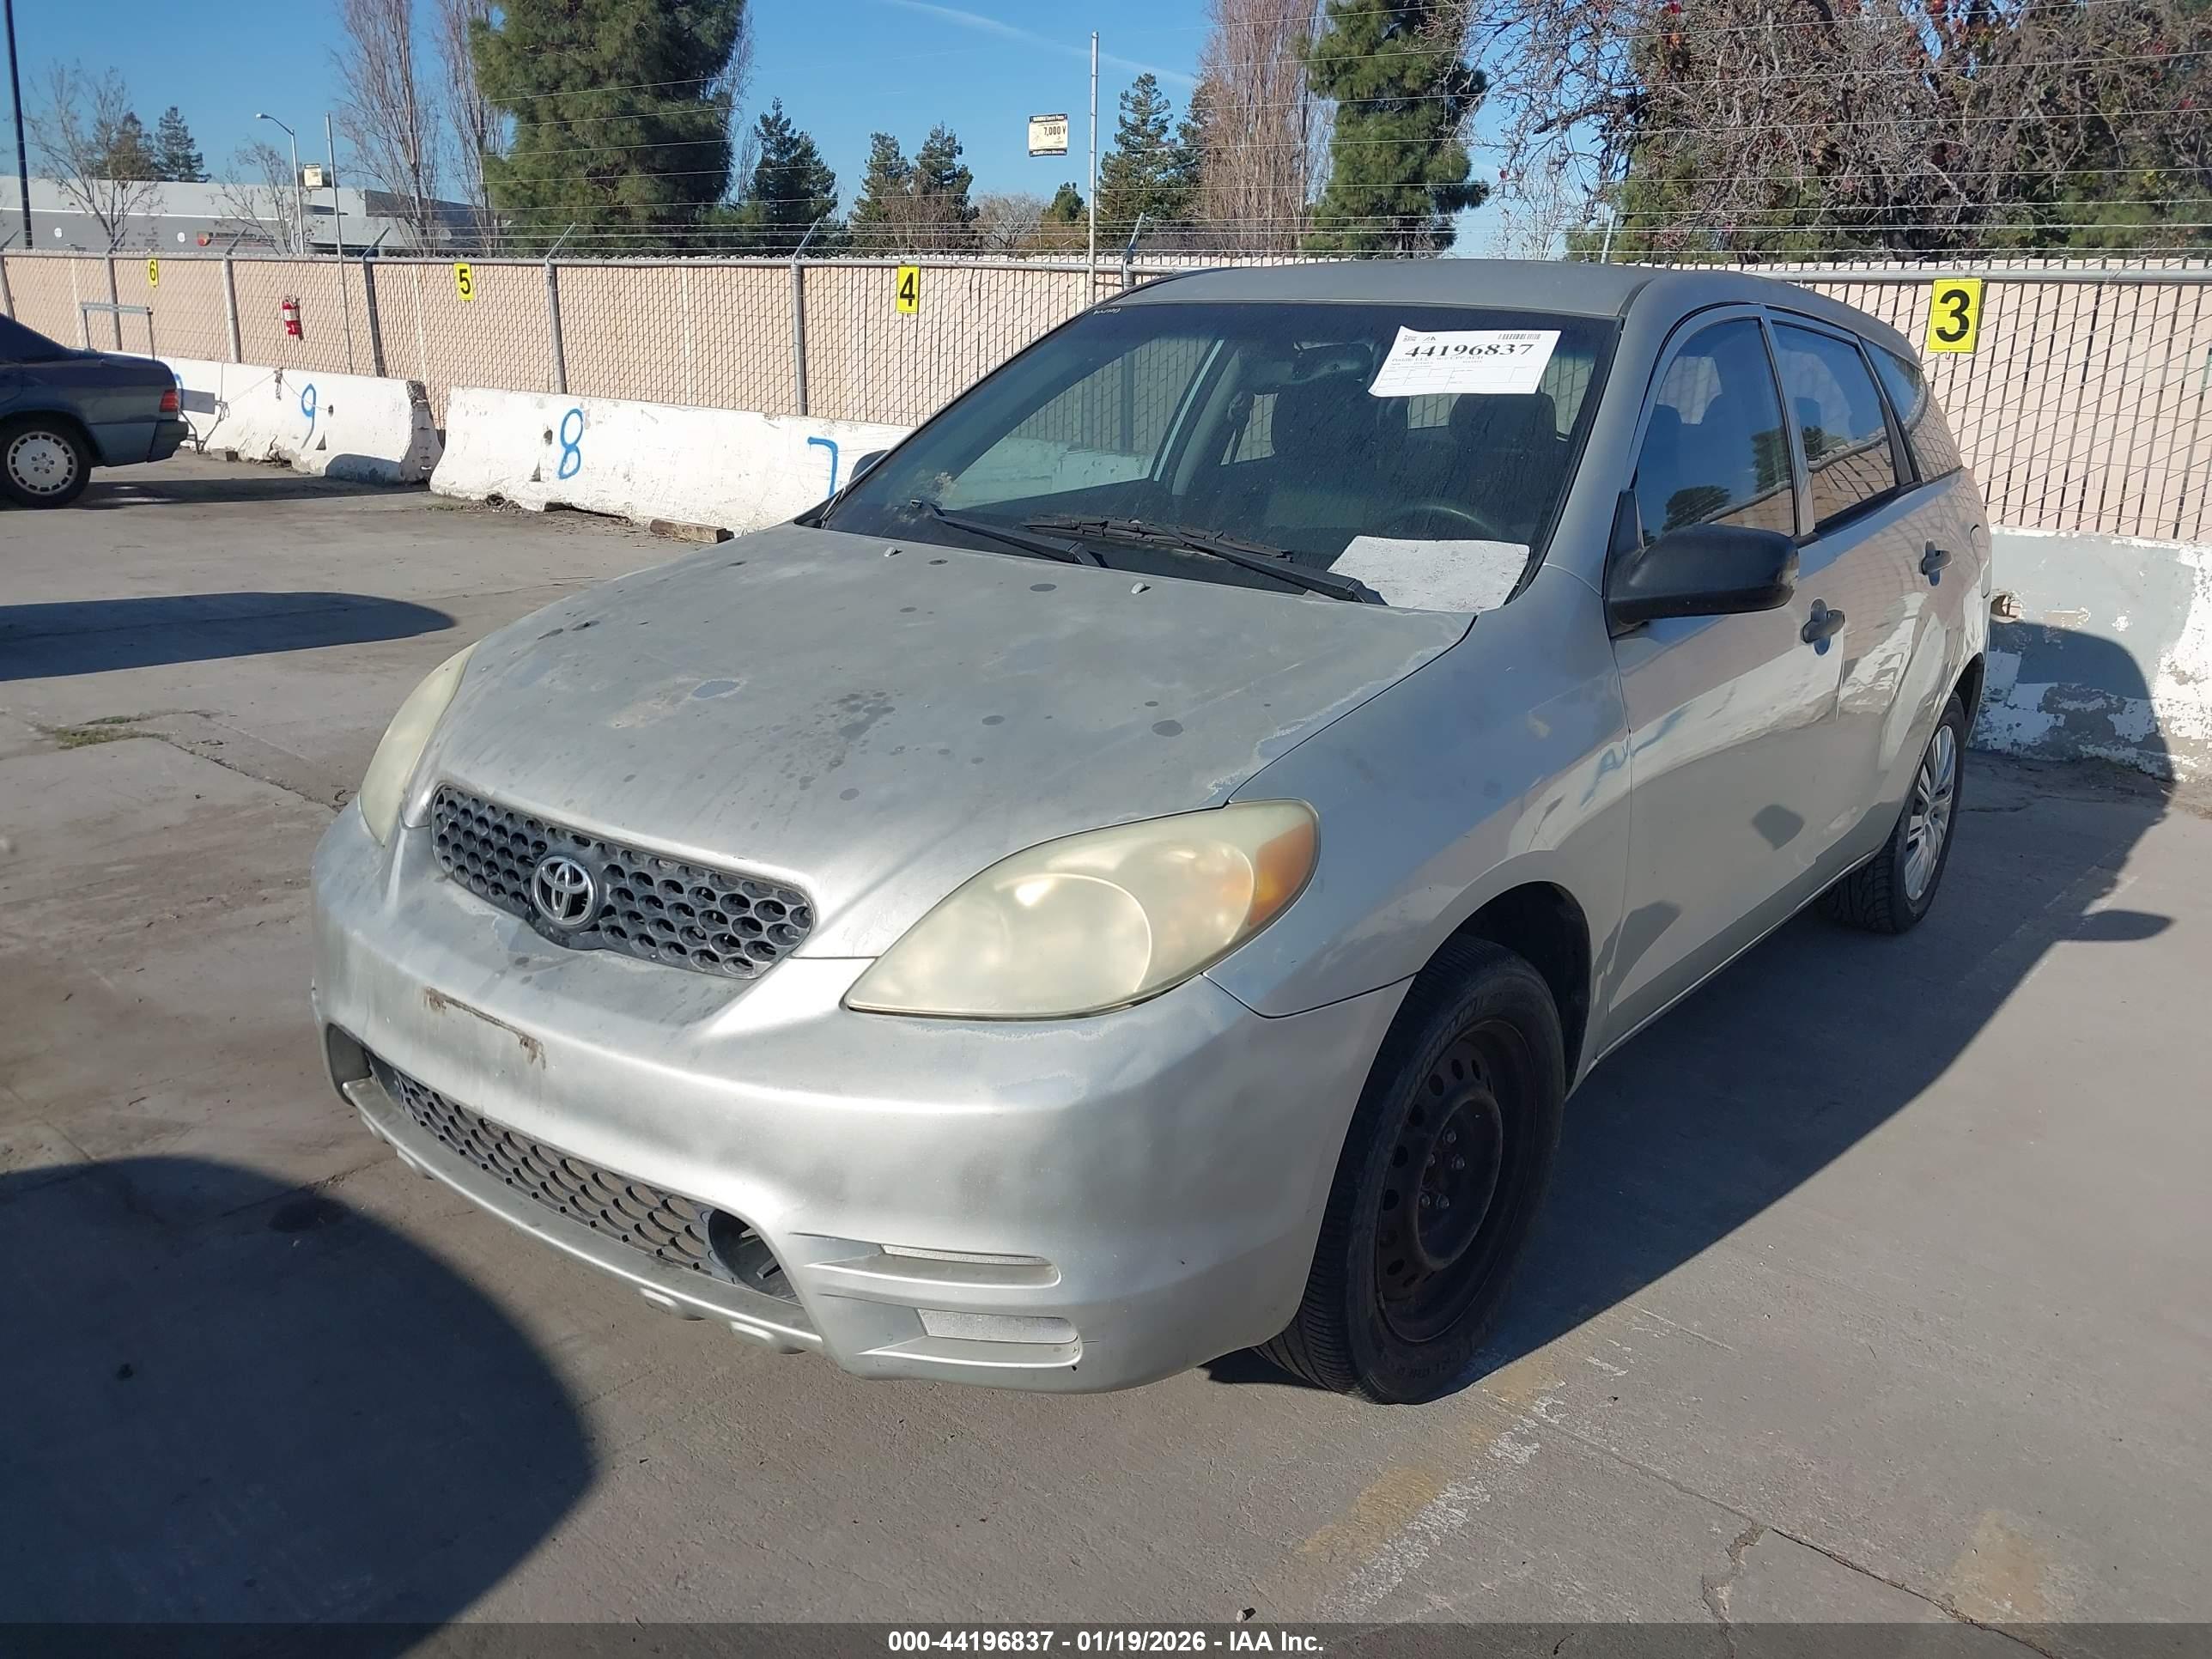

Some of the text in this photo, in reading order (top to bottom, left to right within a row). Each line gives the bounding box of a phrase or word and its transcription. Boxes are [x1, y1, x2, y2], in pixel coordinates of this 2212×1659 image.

[149, 260, 156, 282] 6
[459, 268, 471, 295] 5
[899, 271, 916, 307] 4
[1936, 289, 1971, 343] 3
[1404, 343, 1534, 357] 44196837
[301, 382, 317, 448] 9
[558, 408, 584, 480] 8
[807, 436, 839, 498] 7
